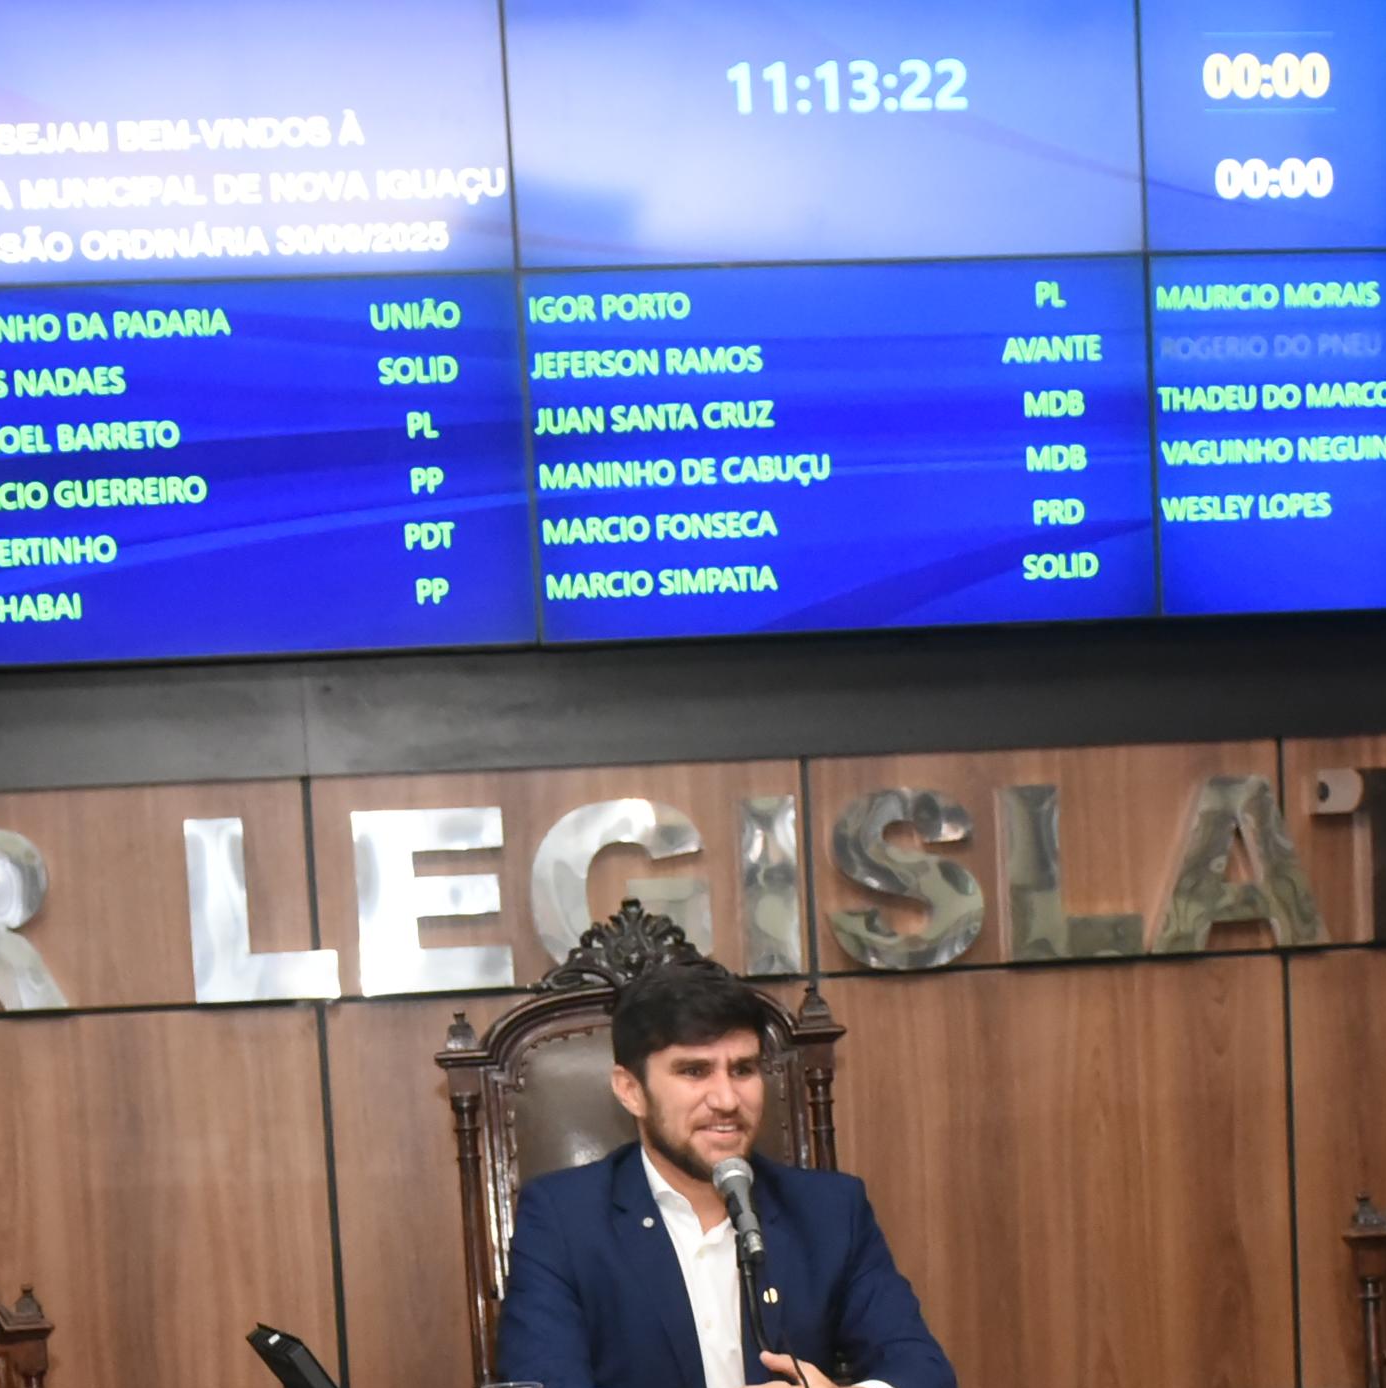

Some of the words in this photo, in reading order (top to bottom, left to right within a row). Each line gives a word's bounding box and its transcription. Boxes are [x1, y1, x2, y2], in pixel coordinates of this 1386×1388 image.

[726, 58, 968, 114] 11:13:22
[1203, 53, 1330, 99] 00:00
[117, 115, 331, 152] BEM-VINDOS
[20, 171, 205, 210] MUNICIPAL
[214, 171, 262, 204] DE
[271, 168, 370, 203] NOVA
[377, 167, 505, 205] IGUAÇU
[1215, 158, 1333, 199] 00:00
[80, 221, 269, 261] ORDINÁRIA
[529, 297, 595, 323] IGOR
[602, 292, 691, 321] PORTO
[1035, 281, 1065, 306] PL
[1156, 284, 1279, 311] MAURICIO
[1285, 281, 1380, 308] MORAIS
[67, 313, 107, 341] DA
[114, 309, 231, 339] PADARIA
[369, 299, 461, 331] UNIÃO
[1002, 335, 1101, 364] AVANTE
[1161, 334, 1268, 359] ROGERIO
[1274, 333, 1312, 357] DO
[1318, 331, 1382, 356] PNEU
[378, 356, 458, 385] SOLID
[531, 349, 659, 380] JEFERSON
[667, 345, 763, 375] RAMOS
[14, 366, 125, 398] NADAES
[1024, 391, 1084, 418] MDB
[1159, 385, 1256, 412] THADEU
[1262, 384, 1300, 409] DO
[407, 412, 439, 439] PL
[534, 406, 605, 435] JUAN
[612, 403, 699, 432] SANTA
[704, 401, 774, 429] CRUZ
[57, 421, 181, 452] BARRETO
[1161, 438, 1292, 466] VAGUINHO
[539, 460, 676, 490] MANINHO
[682, 459, 716, 485] DE
[721, 454, 831, 486] CABUÇU
[1025, 446, 1087, 472] MDB
[54, 475, 207, 509] GUERREIRO
[411, 467, 443, 494] PP
[1032, 499, 1084, 526] PRD
[1161, 495, 1254, 522] WESLEY
[1259, 492, 1332, 520] LOPES
[405, 522, 455, 550] PDT
[543, 516, 651, 545] MARCIO
[655, 510, 777, 542] FONSECA
[1023, 552, 1099, 581] SOLID
[416, 578, 449, 604] PP
[546, 571, 653, 600] MARCIO
[659, 566, 777, 596] SIMPATIA
